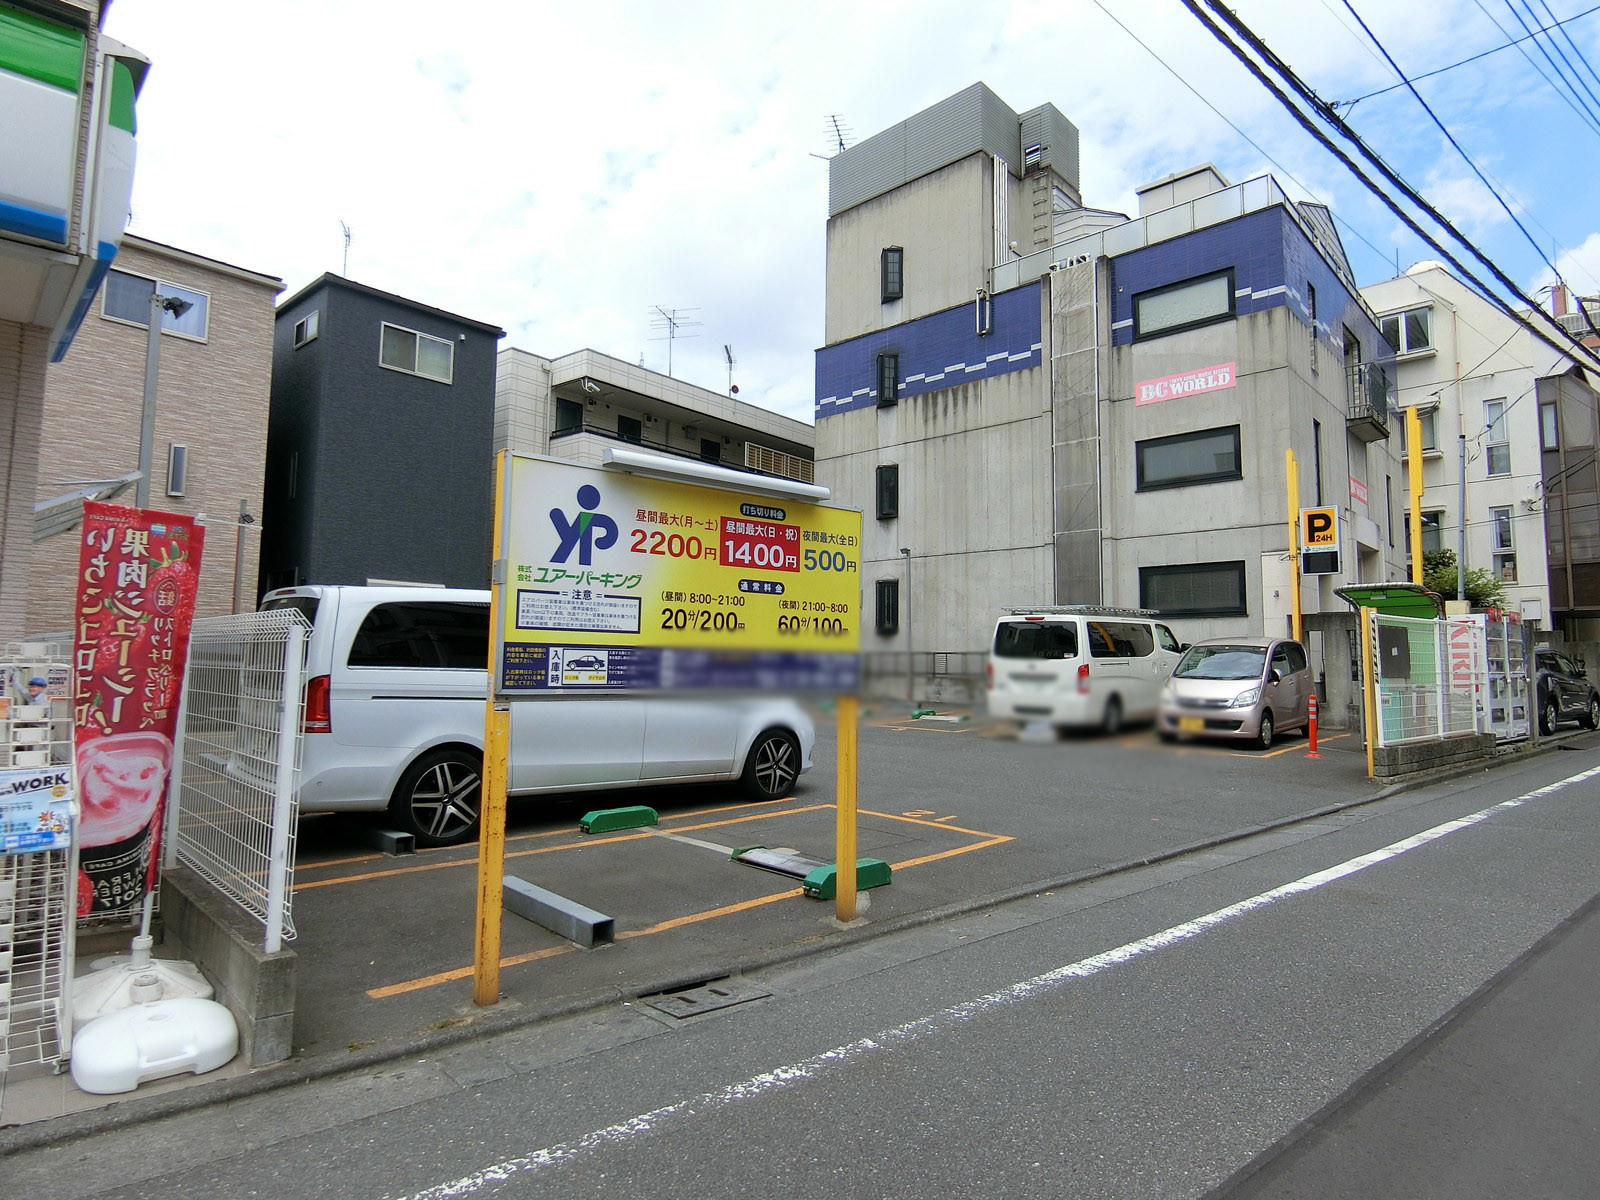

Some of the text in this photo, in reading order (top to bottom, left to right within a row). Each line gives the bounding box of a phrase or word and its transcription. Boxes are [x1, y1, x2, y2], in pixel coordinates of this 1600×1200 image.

[1140, 372, 1230, 402] BC WORLD
[742, 504, 784, 520] 打ち切り料金
[1307, 513, 1332, 543] P
[1315, 533, 1333, 542] 24H
[802, 530, 858, 547] 夜間最大(全日)
[740, 580, 783, 594] 通常料金
[550, 649, 561, 685] 入庫時
[12, 772, 70, 793] WORK
